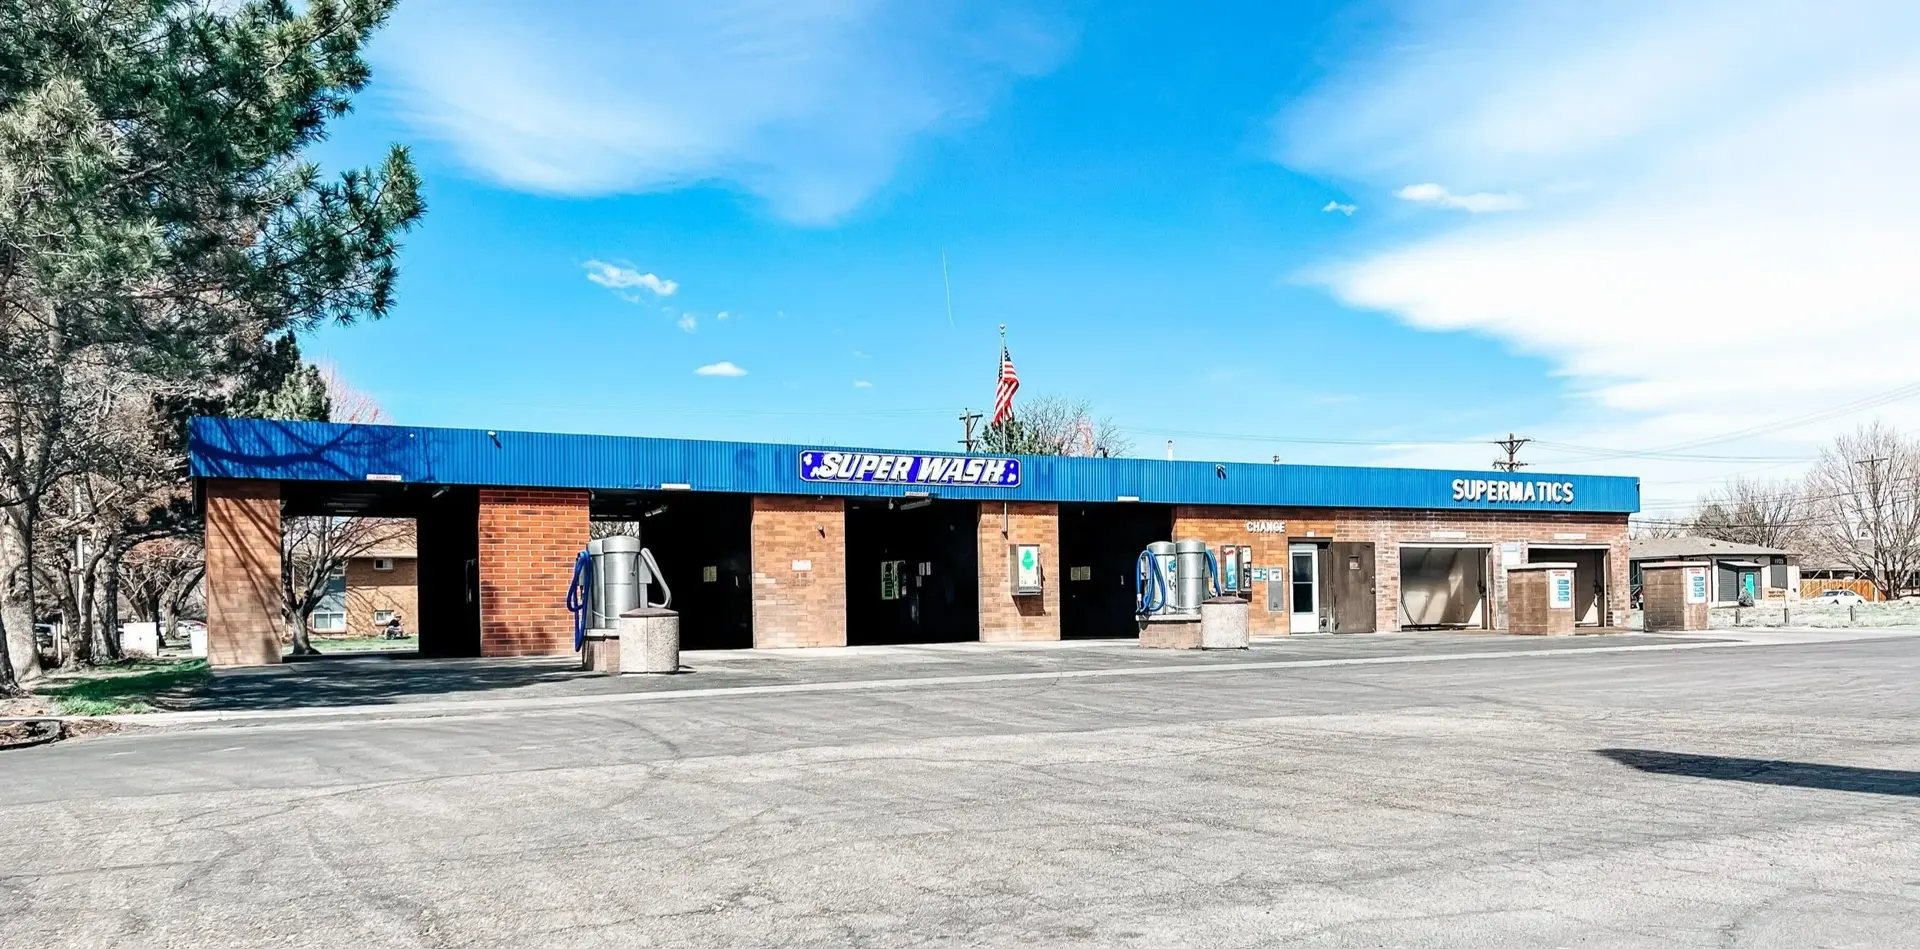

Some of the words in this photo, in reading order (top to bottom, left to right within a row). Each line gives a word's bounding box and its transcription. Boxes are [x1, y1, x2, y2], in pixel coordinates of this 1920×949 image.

[818, 453, 913, 482] SUPER
[916, 456, 1007, 485] WASH
[1452, 479, 1574, 503] SUPERMATICS
[1246, 520, 1286, 533] CHANGE
